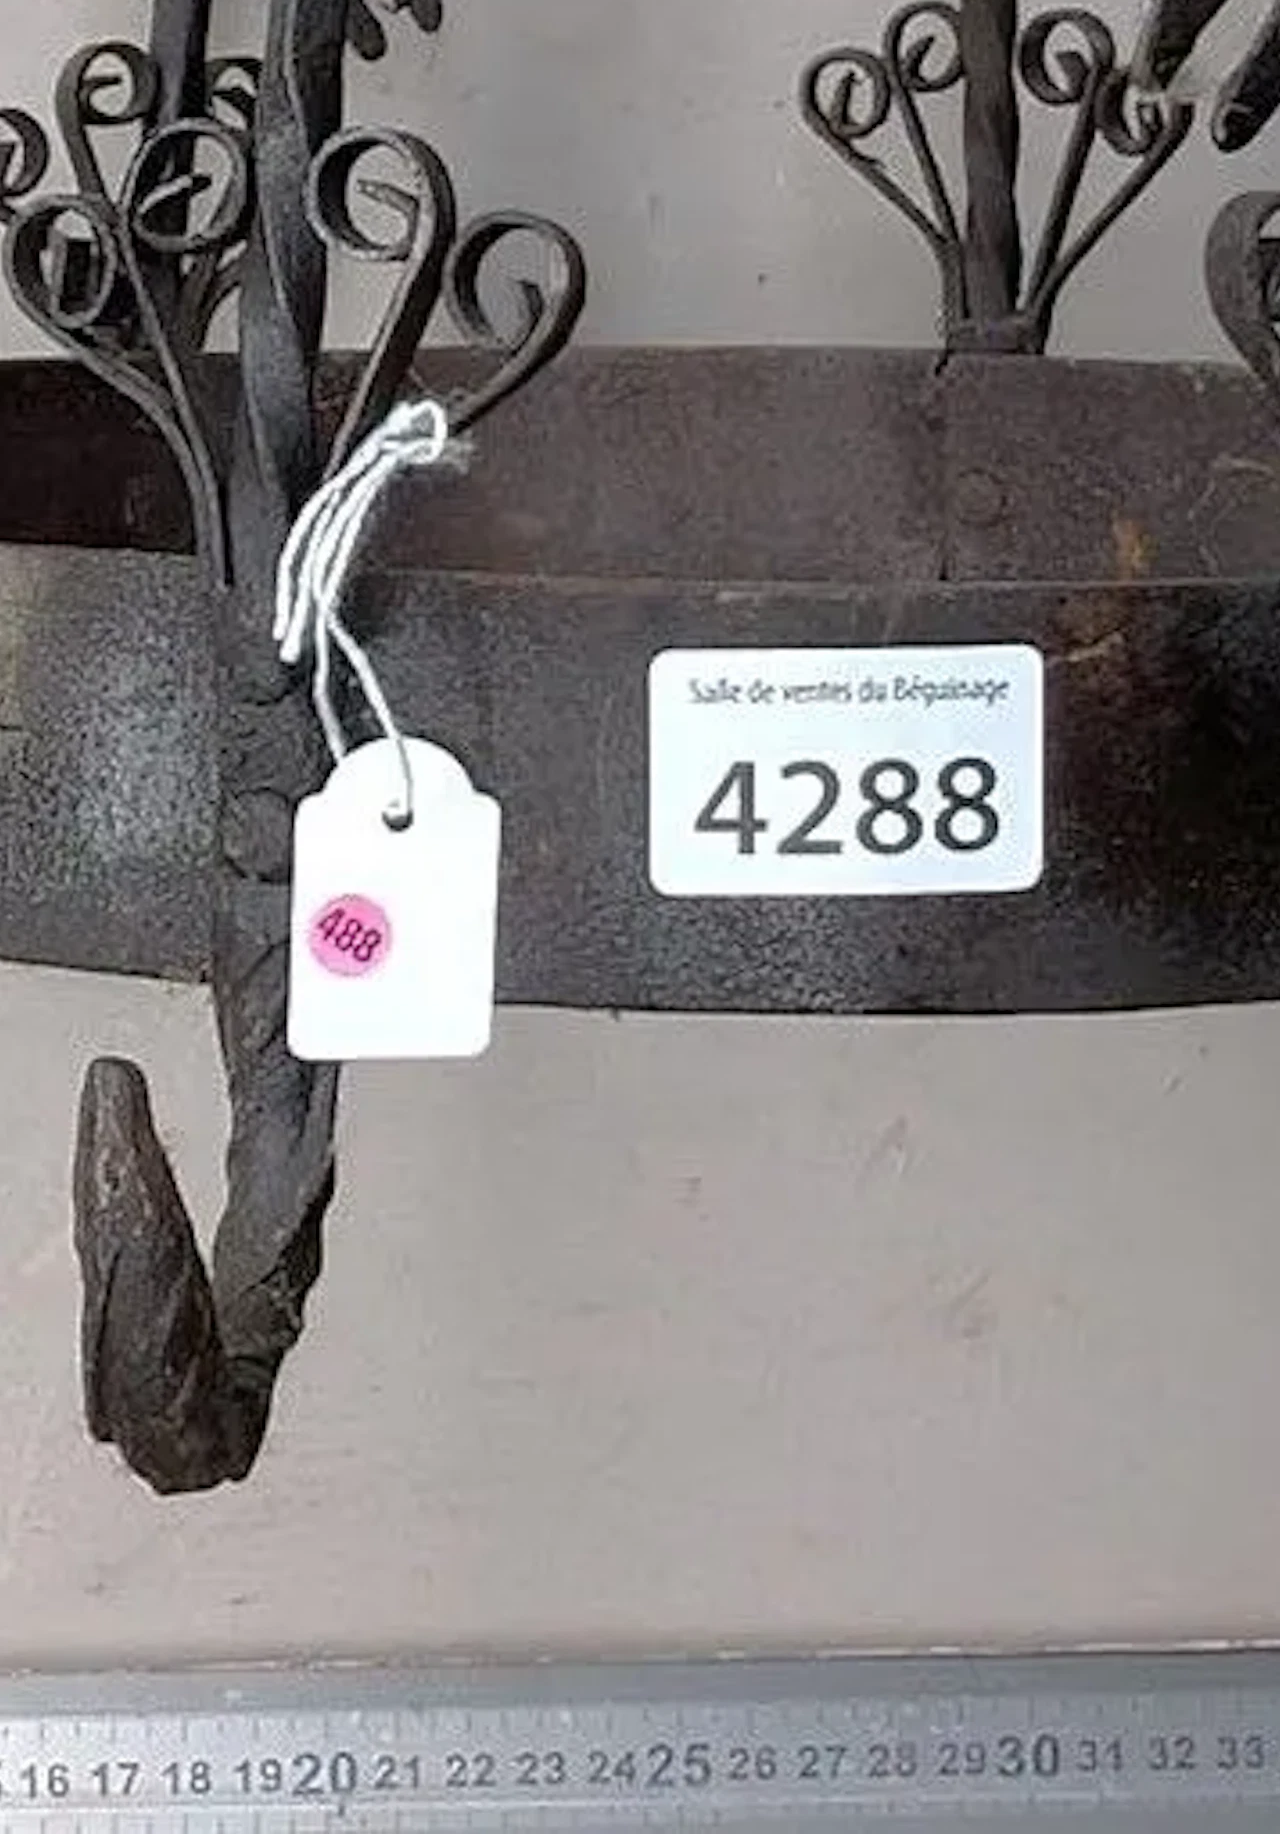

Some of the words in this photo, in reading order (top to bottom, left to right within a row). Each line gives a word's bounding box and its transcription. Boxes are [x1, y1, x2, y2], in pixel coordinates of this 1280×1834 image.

[688, 677, 741, 703] Salle
[748, 677, 775, 703] de
[782, 680, 852, 703] ventes
[858, 677, 887, 703] du
[693, 756, 999, 855] 4288
[317, 908, 382, 962] 488
[22, 1764, 70, 1799] 16
[93, 1763, 140, 1798] 17
[163, 1761, 211, 1795] 18
[236, 1760, 282, 1794] 19
[293, 1752, 357, 1796] 20
[375, 1757, 422, 1790] 21
[447, 1755, 495, 1787] 22
[519, 1753, 565, 1785] 23
[588, 1752, 636, 1784] 24
[648, 1743, 712, 1787] 25
[729, 1747, 777, 1781] 26
[798, 1746, 847, 1780] 27
[868, 1744, 918, 1777] 28
[938, 1742, 986, 1776] 29
[997, 1735, 1061, 1778] 30
[1078, 1740, 1122, 1773] 31
[1149, 1737, 1197, 1771] 32
[1218, 1736, 1266, 1770] 33
